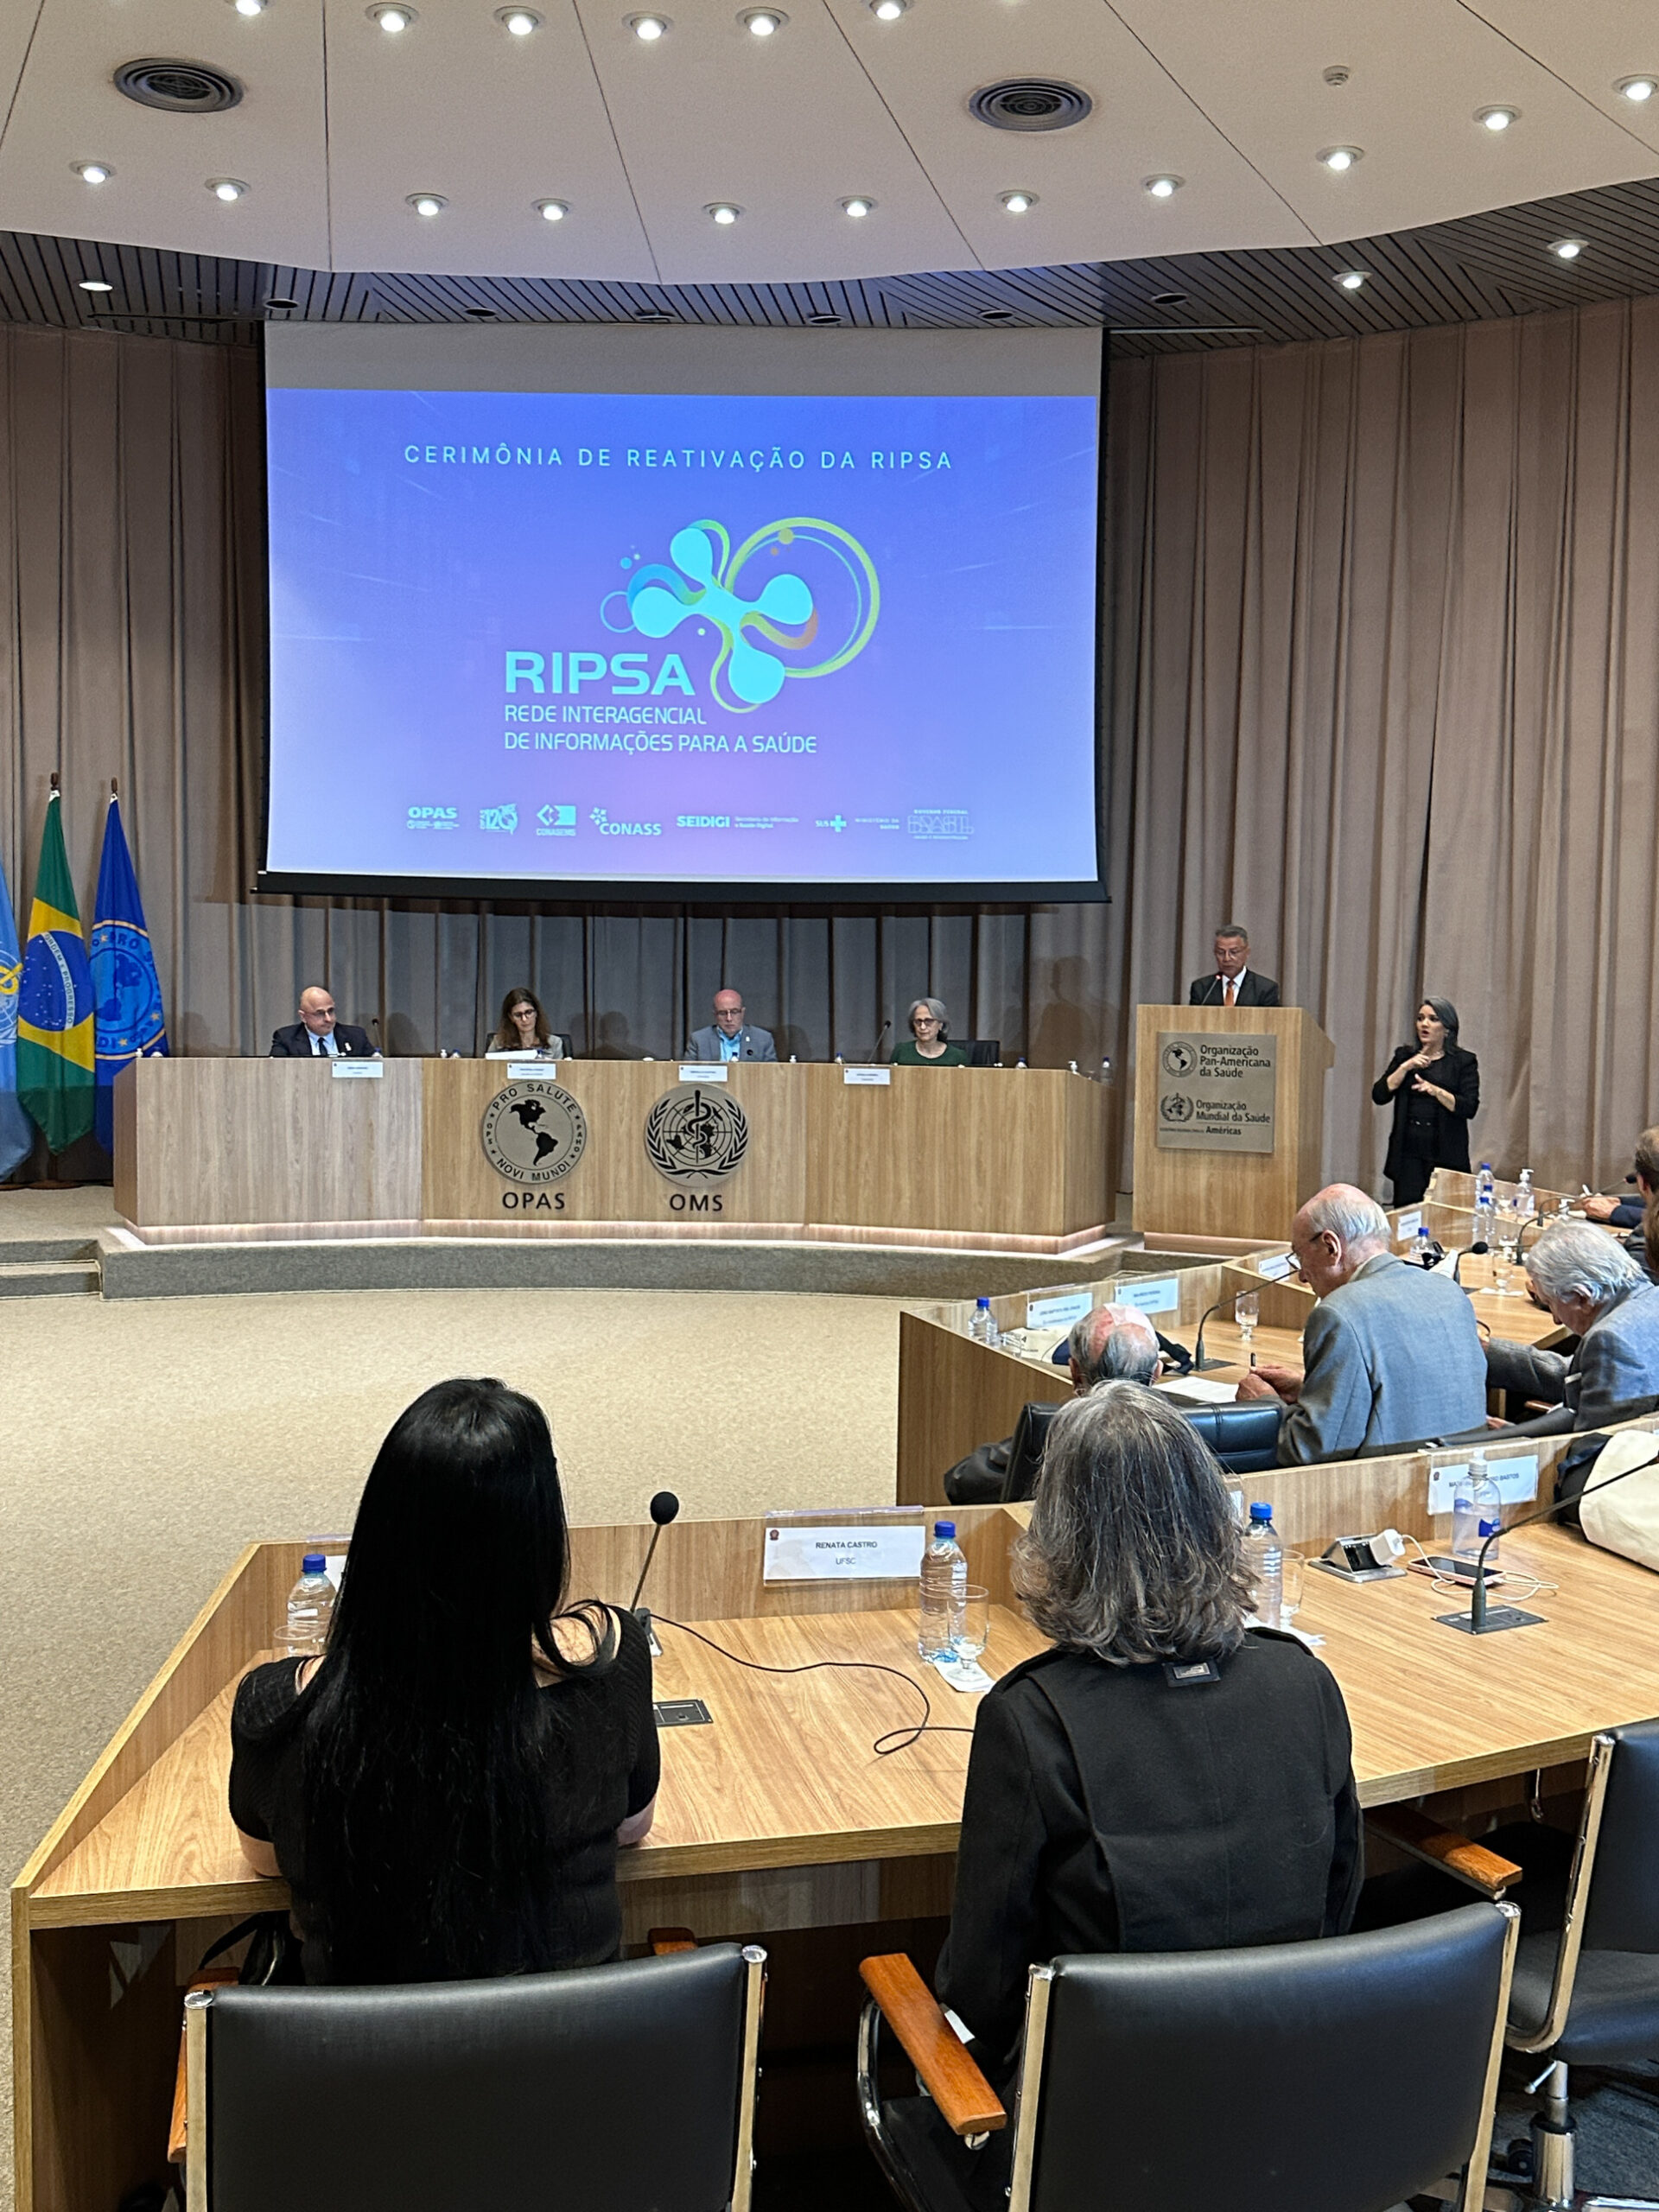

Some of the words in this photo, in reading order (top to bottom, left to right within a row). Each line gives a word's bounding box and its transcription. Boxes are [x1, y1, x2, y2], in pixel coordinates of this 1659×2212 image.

[404, 442, 563, 466] CERIMÔNIA
[578, 448, 611, 467] DE
[628, 447, 805, 472] REATIVAÇÃO
[821, 451, 855, 470] DA
[871, 450, 953, 470] RIPSA
[505, 651, 696, 696] RIPSA
[505, 705, 557, 722] REDE
[563, 706, 707, 725] INTERAGENCIAL
[505, 732, 530, 750] DE
[535, 730, 673, 755] INFORMAÇÕES
[678, 734, 729, 753] PARA
[734, 735, 748, 753] A
[753, 731, 817, 753] SAÚDE
[408, 806, 458, 819] OPAS
[677, 815, 731, 828] SEIDIGI
[599, 823, 663, 836] CONASS
[44, 933, 63, 962] ORDEM
[61, 970, 75, 1024] PROGRESSO
[1200, 1044, 1259, 1058] Organização
[1199, 1056, 1271, 1067] Pan-Americana
[1199, 1066, 1211, 1077] da
[1214, 1067, 1243, 1077] Saúde
[493, 1088, 518, 1110] PRO
[527, 1083, 577, 1113] SALUTE
[1196, 1099, 1247, 1113] Organização
[1196, 1110, 1229, 1121] Mundial
[1231, 1112, 1243, 1122] da
[1245, 1112, 1271, 1122] Saúde
[1205, 1126, 1242, 1135] Américas
[497, 1158, 524, 1179] NOVI
[531, 1160, 571, 1181] MUNDI
[502, 1192, 565, 1211] OPAS
[670, 1193, 723, 1211] OMS
[847, 1541, 878, 1549] CASTRO
